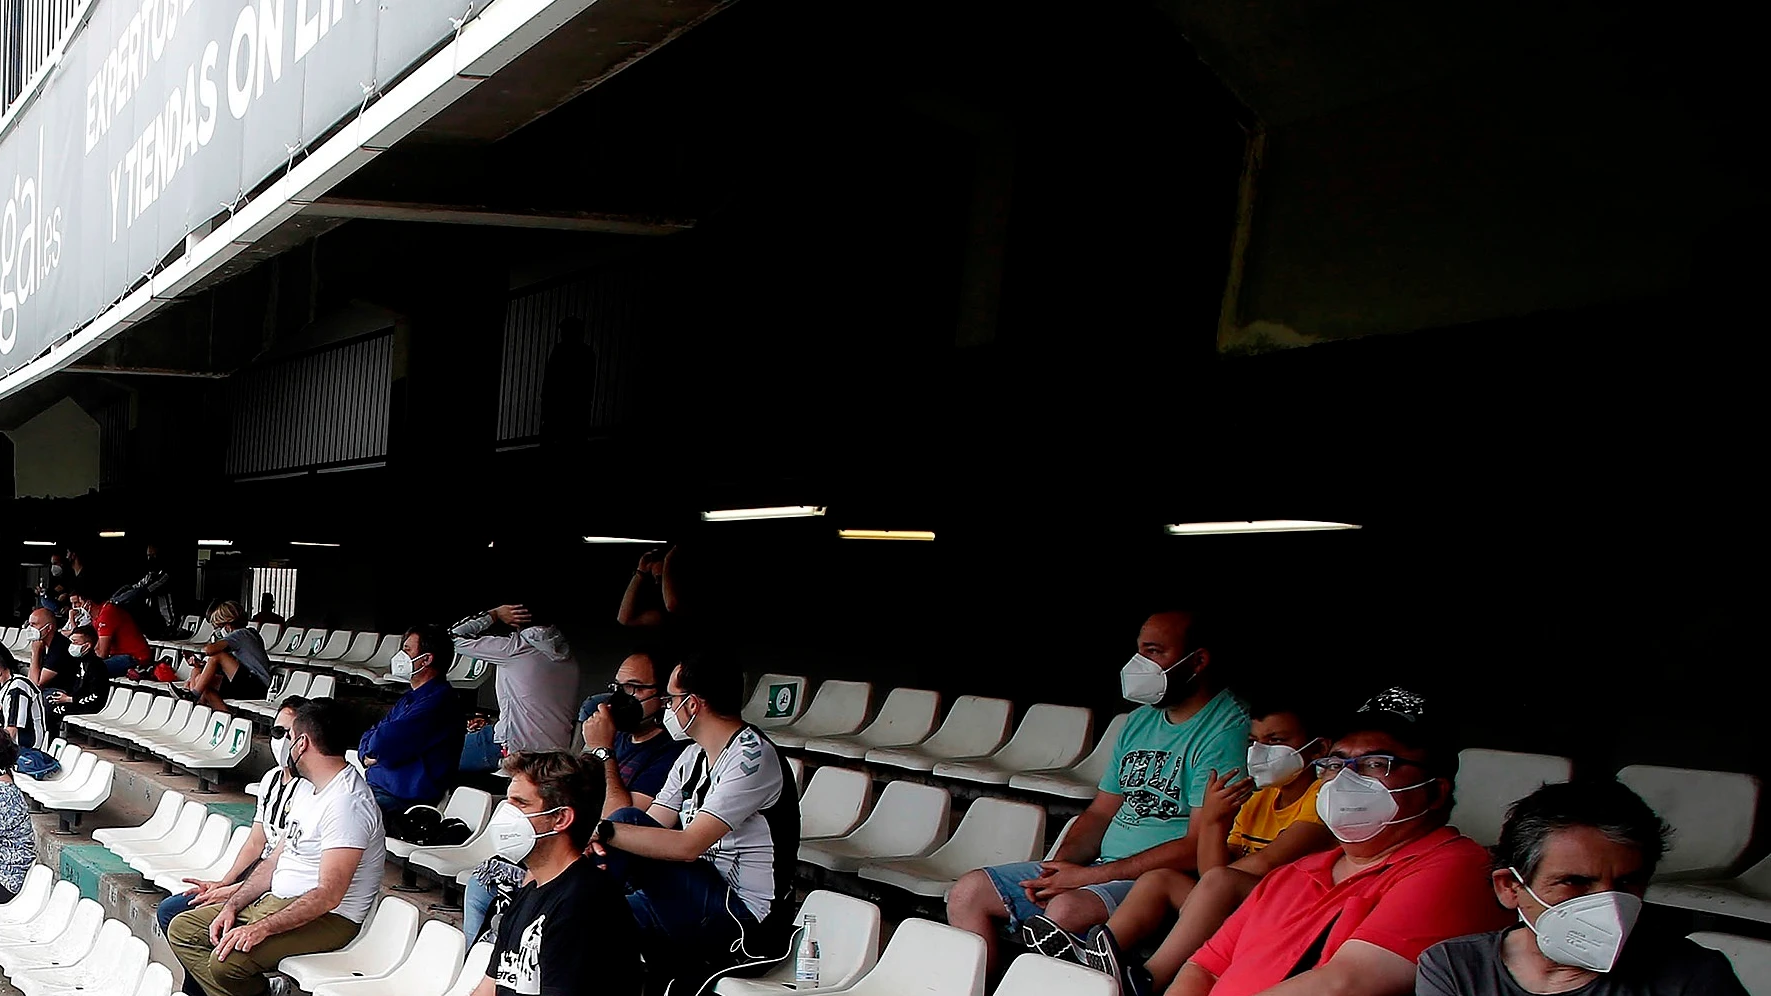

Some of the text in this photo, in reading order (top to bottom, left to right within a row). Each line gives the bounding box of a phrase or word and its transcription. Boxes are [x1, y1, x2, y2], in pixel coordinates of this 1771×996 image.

[110, 0, 283, 244] Y TIENDAS ON
